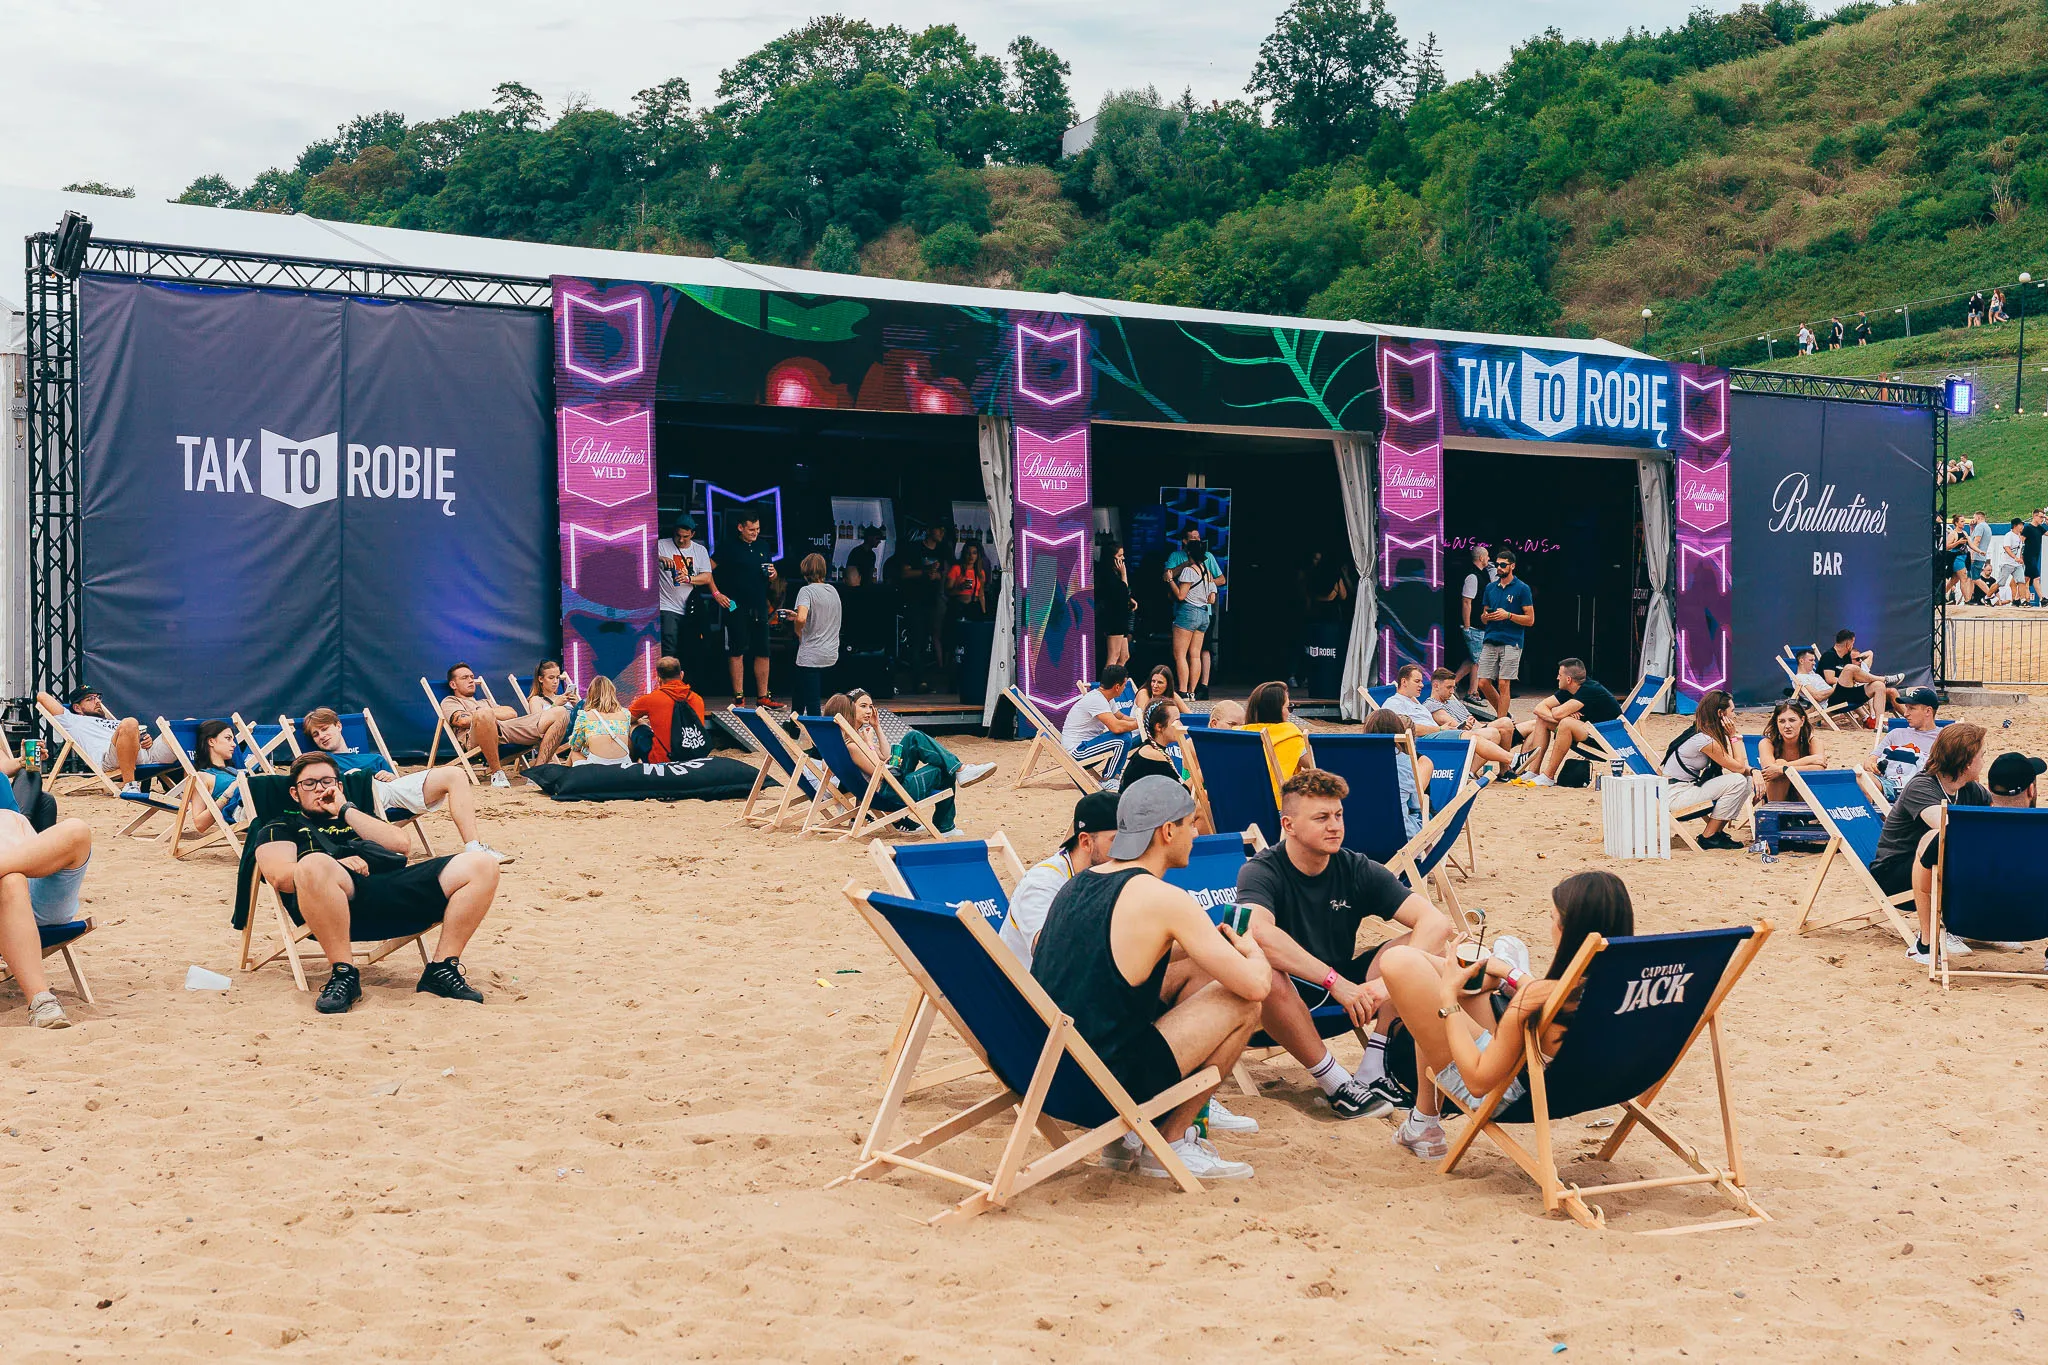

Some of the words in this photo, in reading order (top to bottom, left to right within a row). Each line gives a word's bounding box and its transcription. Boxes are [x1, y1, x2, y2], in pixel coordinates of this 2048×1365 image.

[1458, 358, 1515, 420] TAK
[1534, 372, 1565, 422] TO
[1584, 368, 1668, 447] ROBIĘ
[570, 435, 646, 464] Ballantine's
[591, 466, 627, 479] WILD
[1022, 452, 1083, 477] Ballantine's
[1385, 464, 1436, 487] Ballantine's
[176, 436, 254, 493] TAK
[278, 448, 320, 494] TO
[347, 443, 456, 516] ROBIĘ
[1039, 479, 1068, 490] WILD
[1400, 488, 1424, 499] WILD
[1683, 480, 1725, 501] Ballantine's
[1694, 502, 1715, 512] WILD
[1768, 472, 1888, 534] Ballantine's
[1812, 551, 1843, 575] BAR
[1431, 769, 1455, 781] ROBIĘ
[973, 898, 1003, 919] OBIĘ
[1641, 963, 1686, 979] CAPTAIN
[1613, 972, 1694, 1015] JACK
